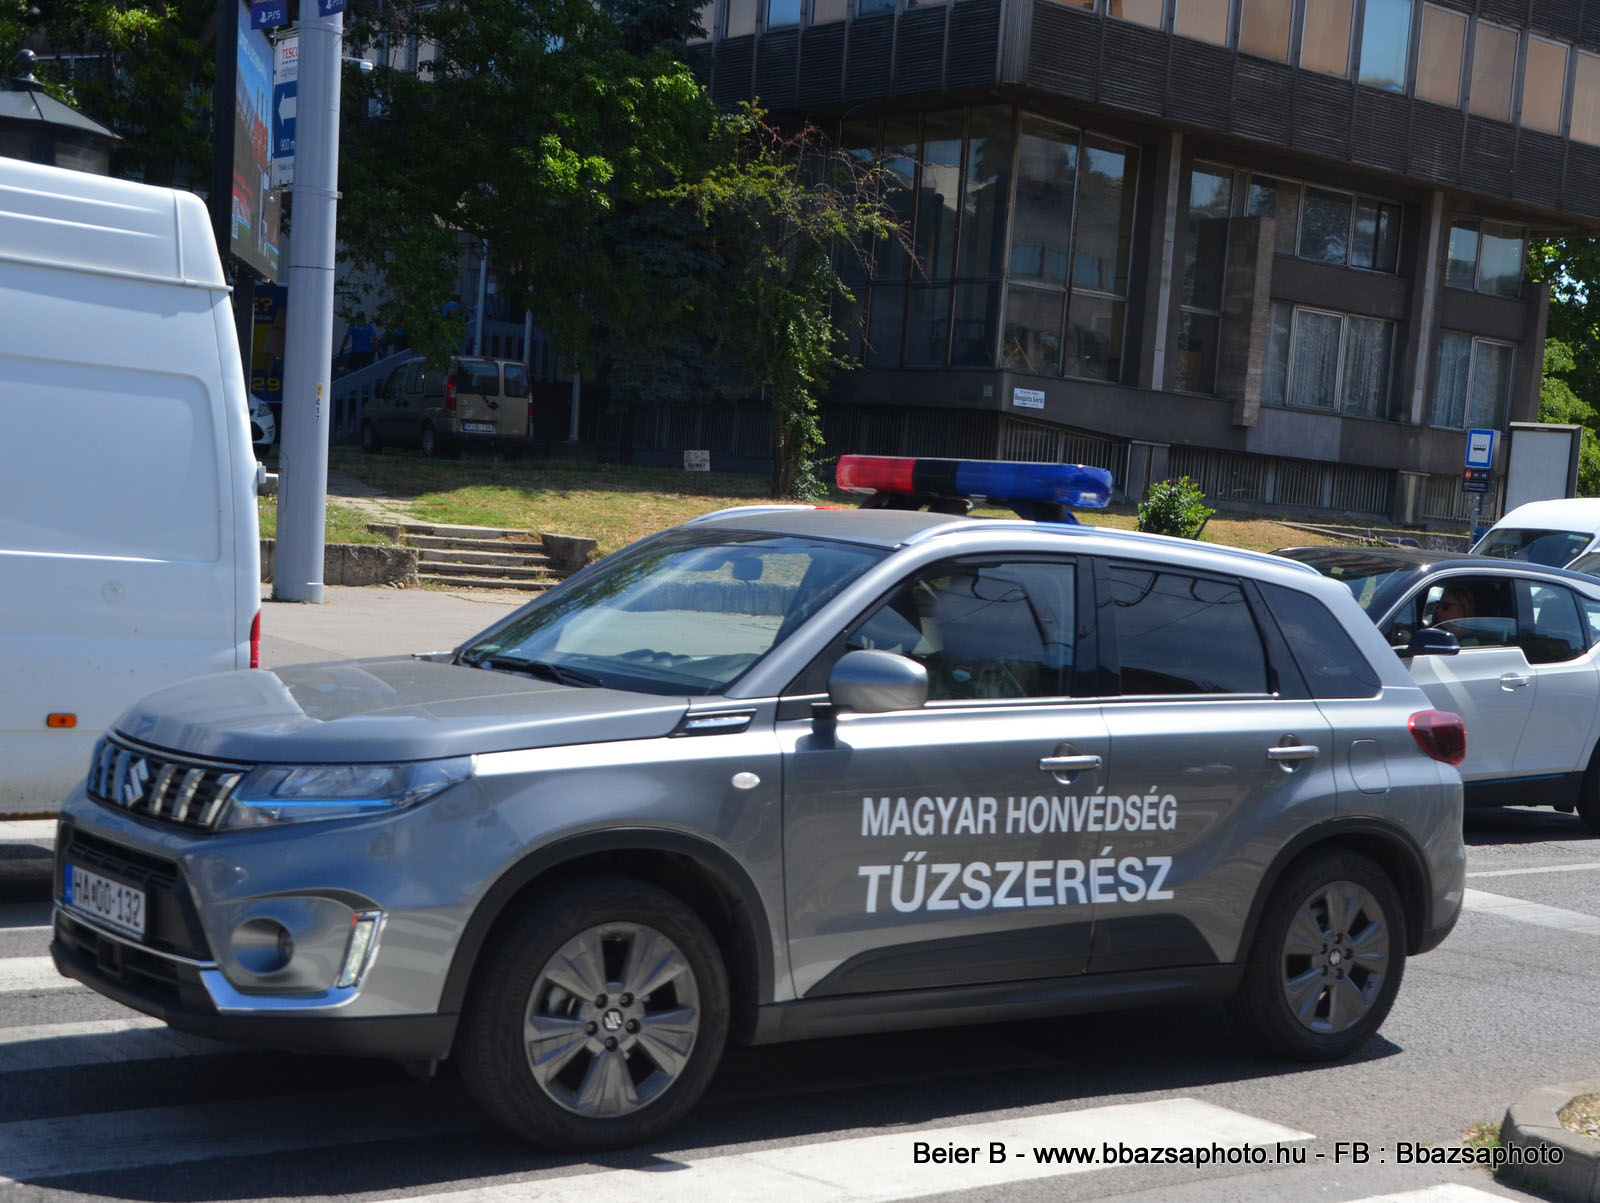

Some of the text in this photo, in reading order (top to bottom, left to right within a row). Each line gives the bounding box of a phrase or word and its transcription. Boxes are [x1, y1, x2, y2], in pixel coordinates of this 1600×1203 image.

[267, 9, 281, 21] PS5
[280, 138, 290, 151] 900
[862, 785, 1177, 836] MAGYAR HONVÉDSÉG
[858, 846, 1174, 914] TŰZSZERÉSZ
